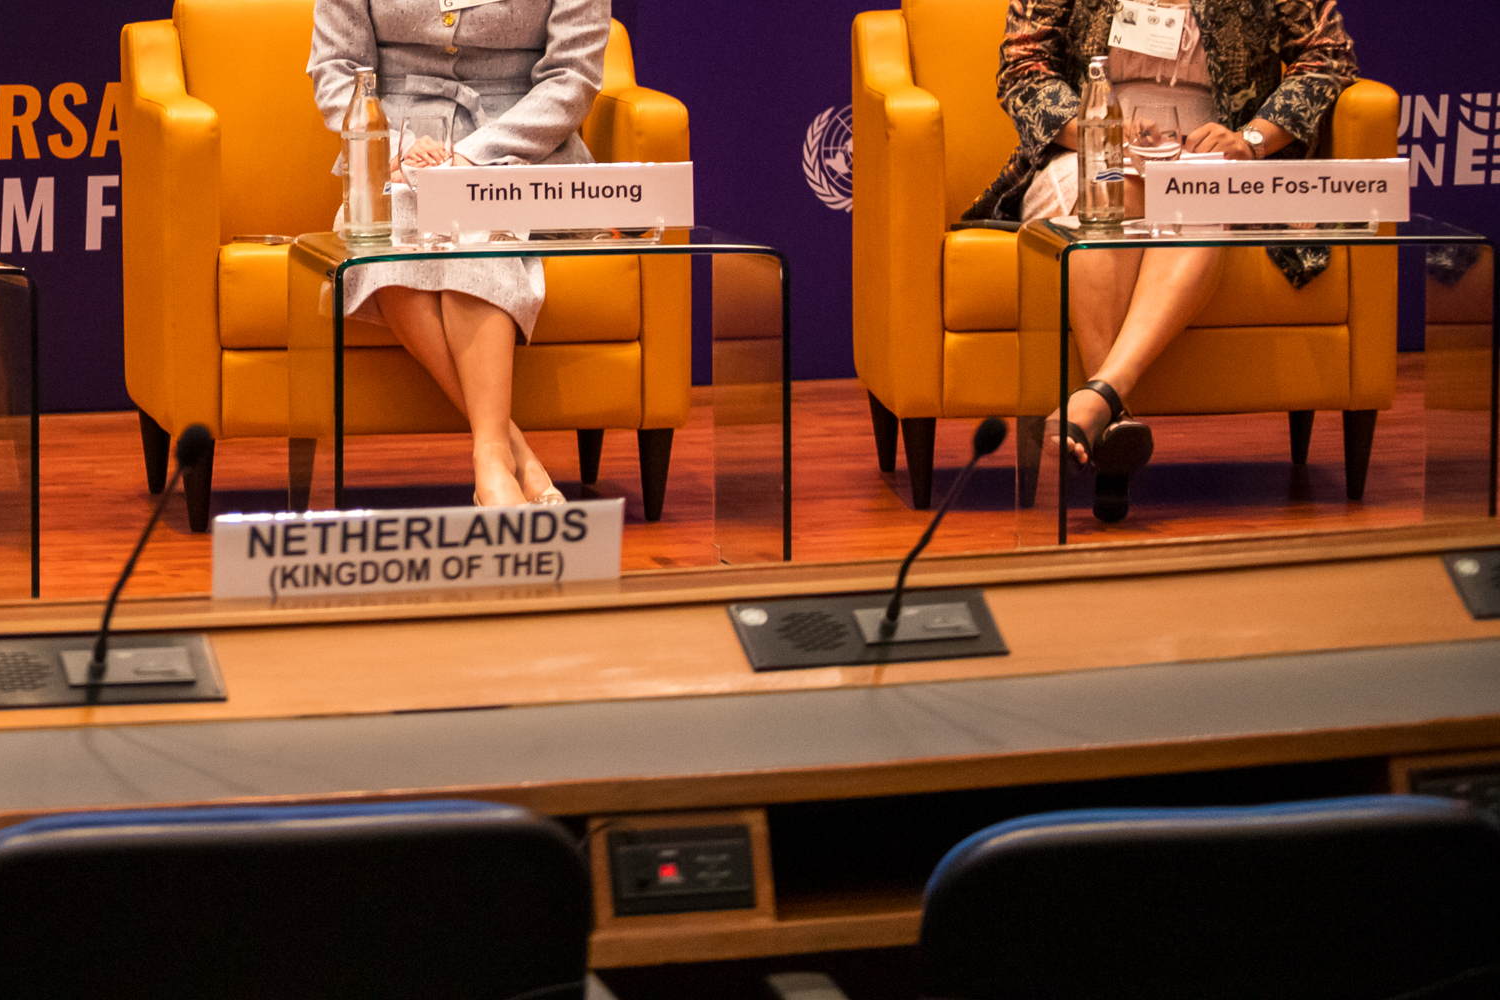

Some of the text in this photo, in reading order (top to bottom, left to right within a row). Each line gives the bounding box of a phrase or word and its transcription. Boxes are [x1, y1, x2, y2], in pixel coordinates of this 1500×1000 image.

[1112, 35, 1122, 45] N
[1165, 176, 1388, 194] Anna Lee Fos-Tuvera
[1397, 143, 1445, 187] N
[85, 175, 119, 251] F
[466, 181, 642, 203] Trinh Thi Huong
[249, 508, 588, 558] NETHERLANDS
[270, 551, 564, 595] (KINGDOM OF THE)
